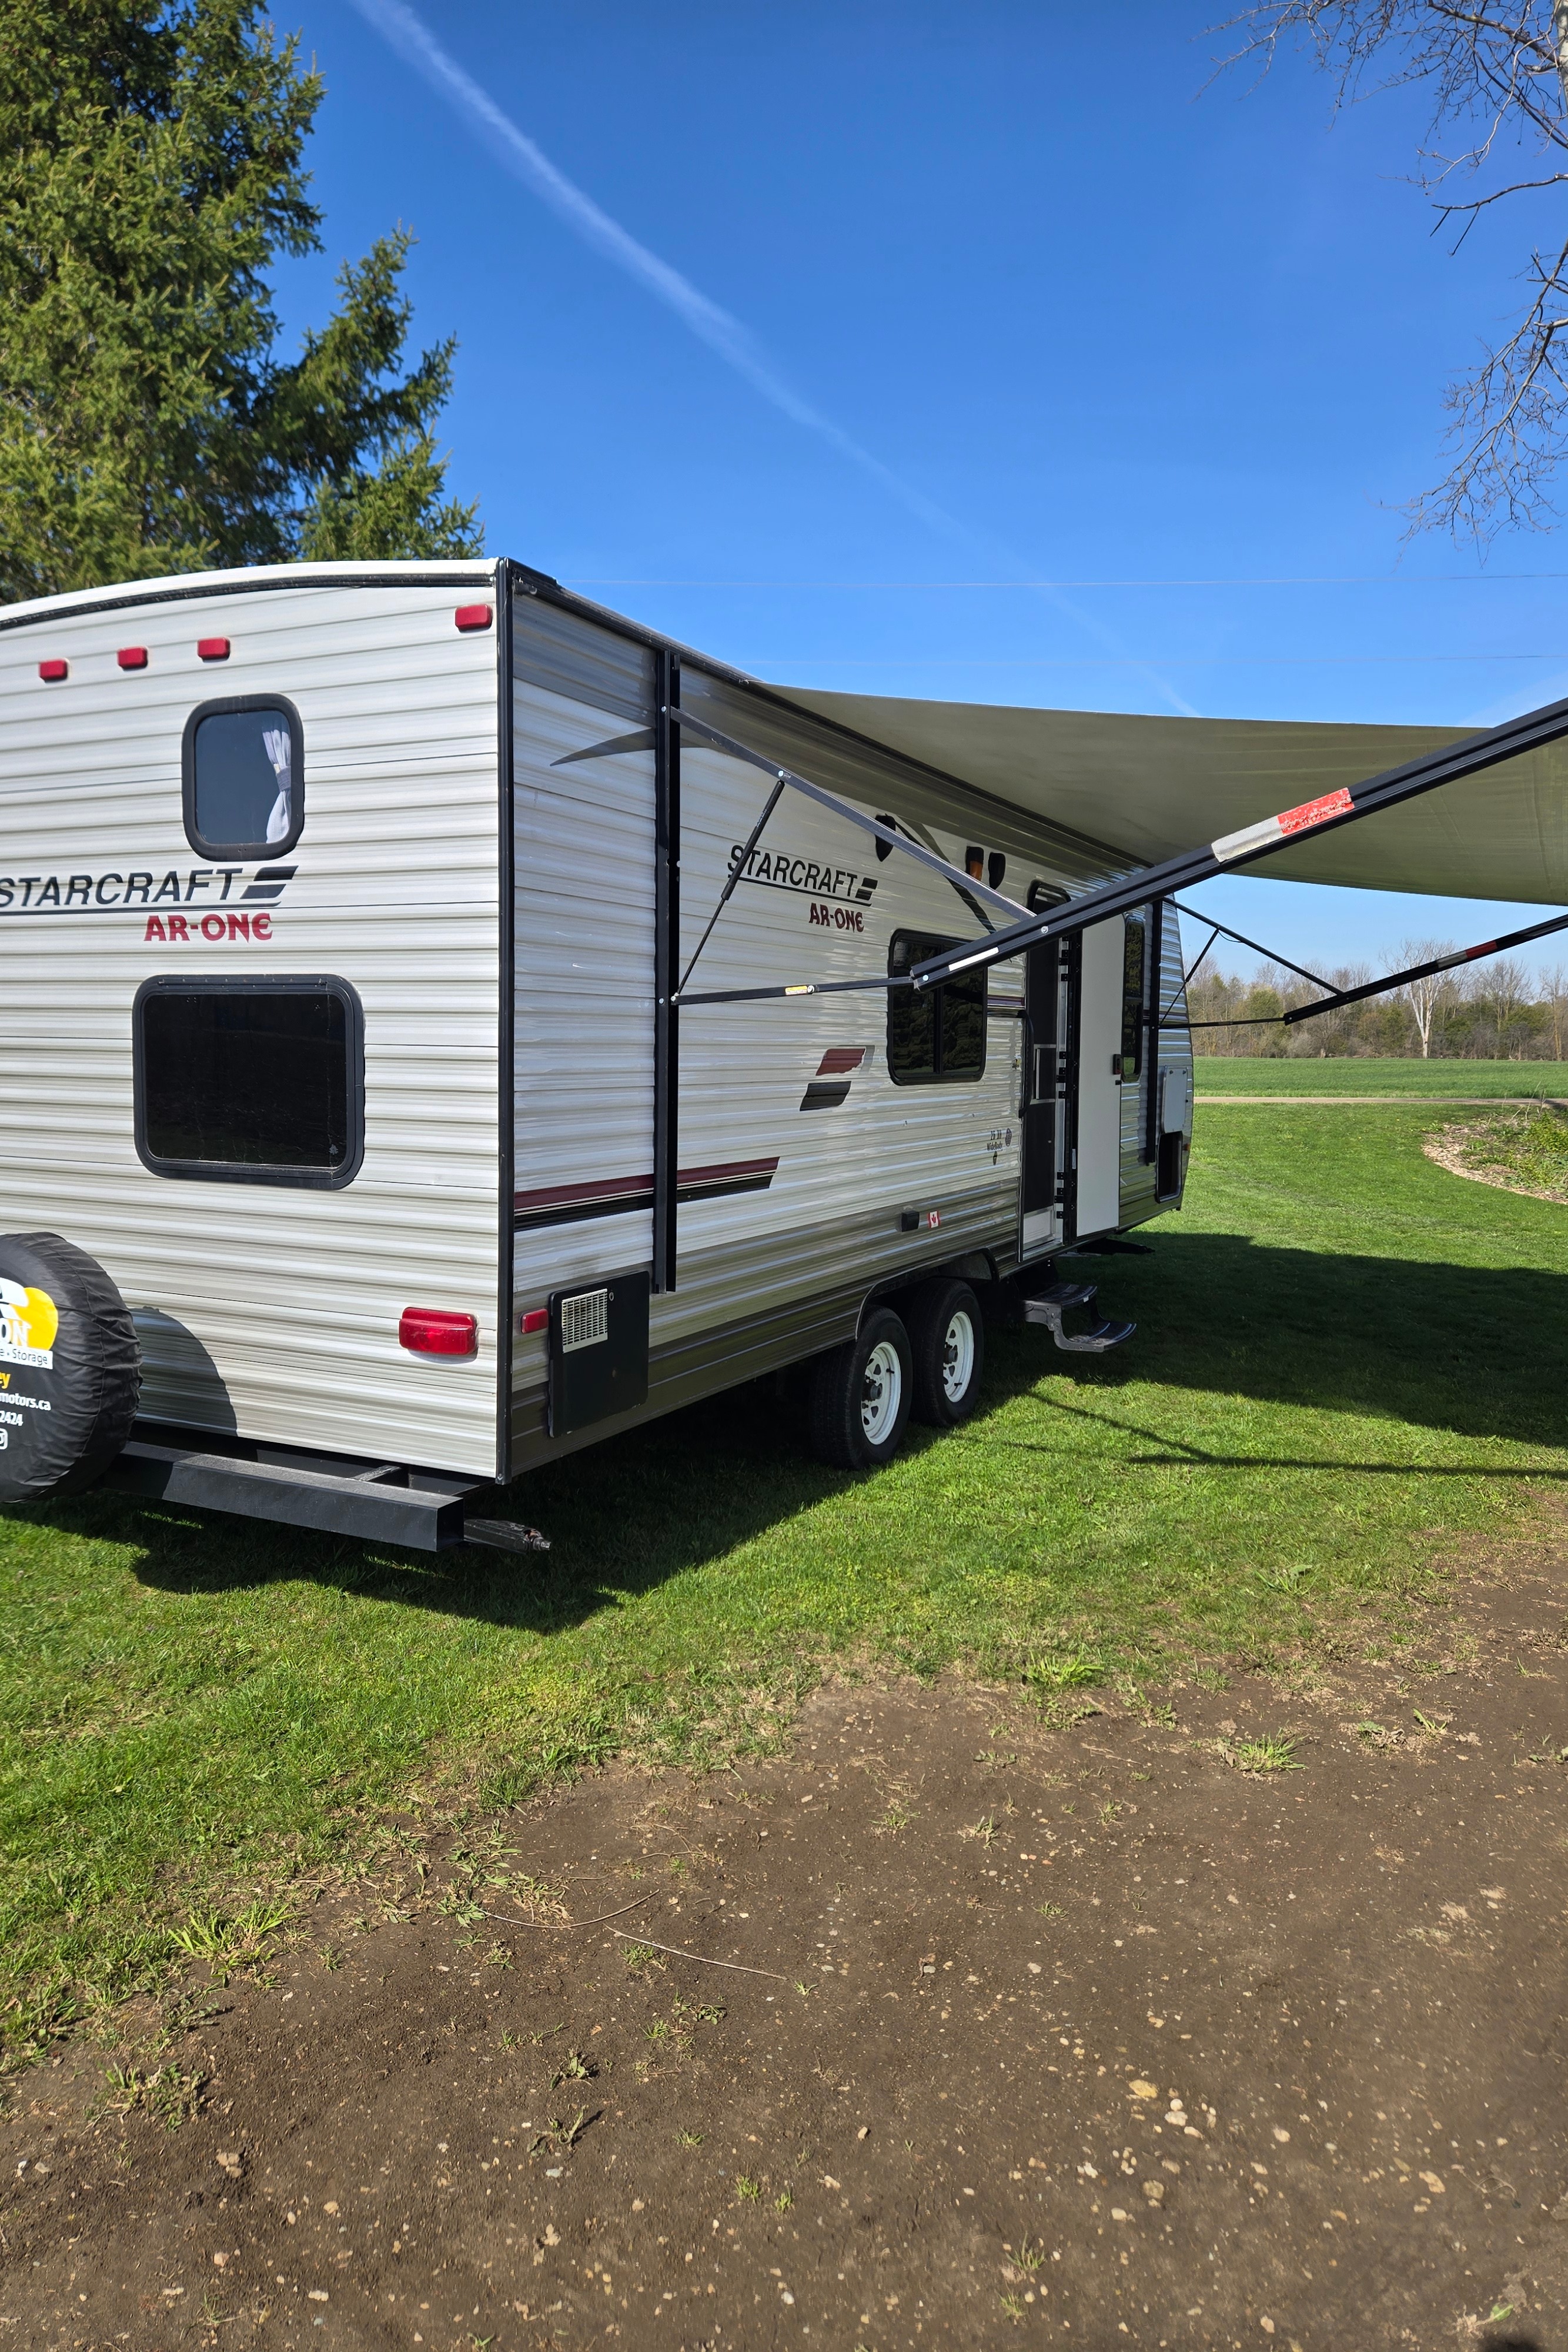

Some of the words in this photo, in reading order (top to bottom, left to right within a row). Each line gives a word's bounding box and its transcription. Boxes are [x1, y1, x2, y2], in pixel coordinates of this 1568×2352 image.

[728, 845, 857, 897] STARCRAFT
[0, 867, 243, 908] STARCRAFT
[143, 913, 273, 943] AR-ONE
[809, 903, 864, 933] AR-ONE
[12, 1349, 48, 1365] Storage
[0, 1411, 24, 1426] 2424
